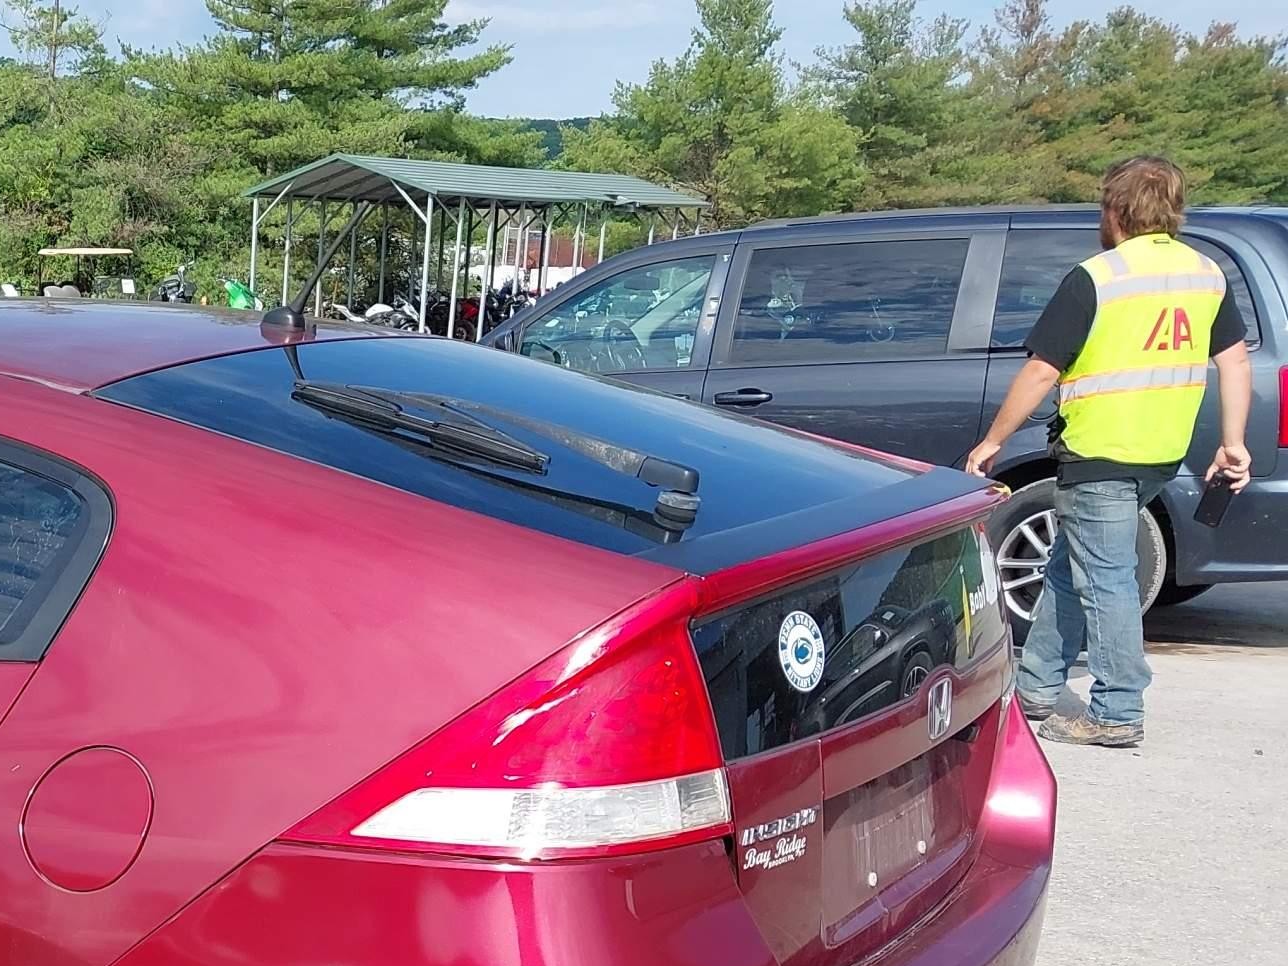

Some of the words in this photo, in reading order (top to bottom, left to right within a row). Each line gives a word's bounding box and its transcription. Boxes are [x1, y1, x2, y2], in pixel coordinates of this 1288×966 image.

[780, 616, 795, 644] PENN
[795, 614, 818, 635] STATE
[743, 848, 771, 870] Bay
[774, 834, 807, 859] Ridge
